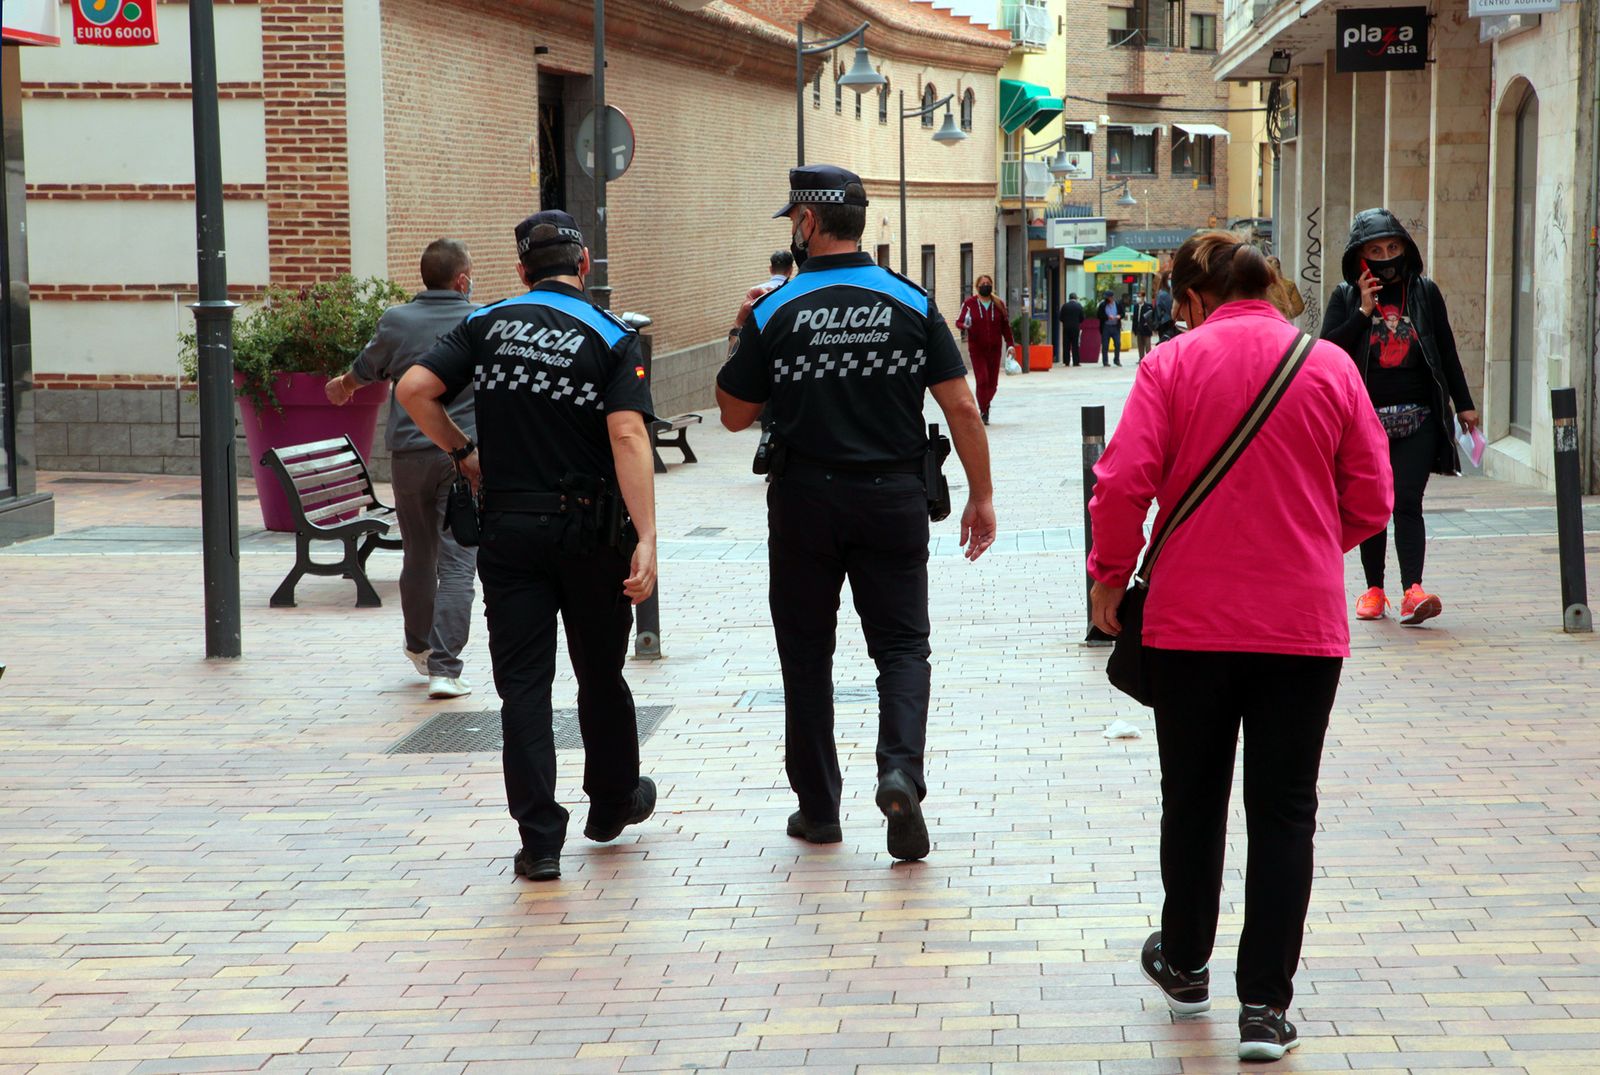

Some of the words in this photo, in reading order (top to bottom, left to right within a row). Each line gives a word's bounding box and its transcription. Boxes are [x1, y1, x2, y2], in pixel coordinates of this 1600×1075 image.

[77, 27, 112, 39] EURO
[115, 27, 151, 39] 6000
[1343, 24, 1414, 56] plaza
[1387, 42, 1418, 54] asia
[792, 302, 892, 332] POLICÍA
[485, 319, 585, 354] POLICÍA
[809, 329, 890, 346] Alcobendas
[494, 341, 574, 368] Alcobendas
